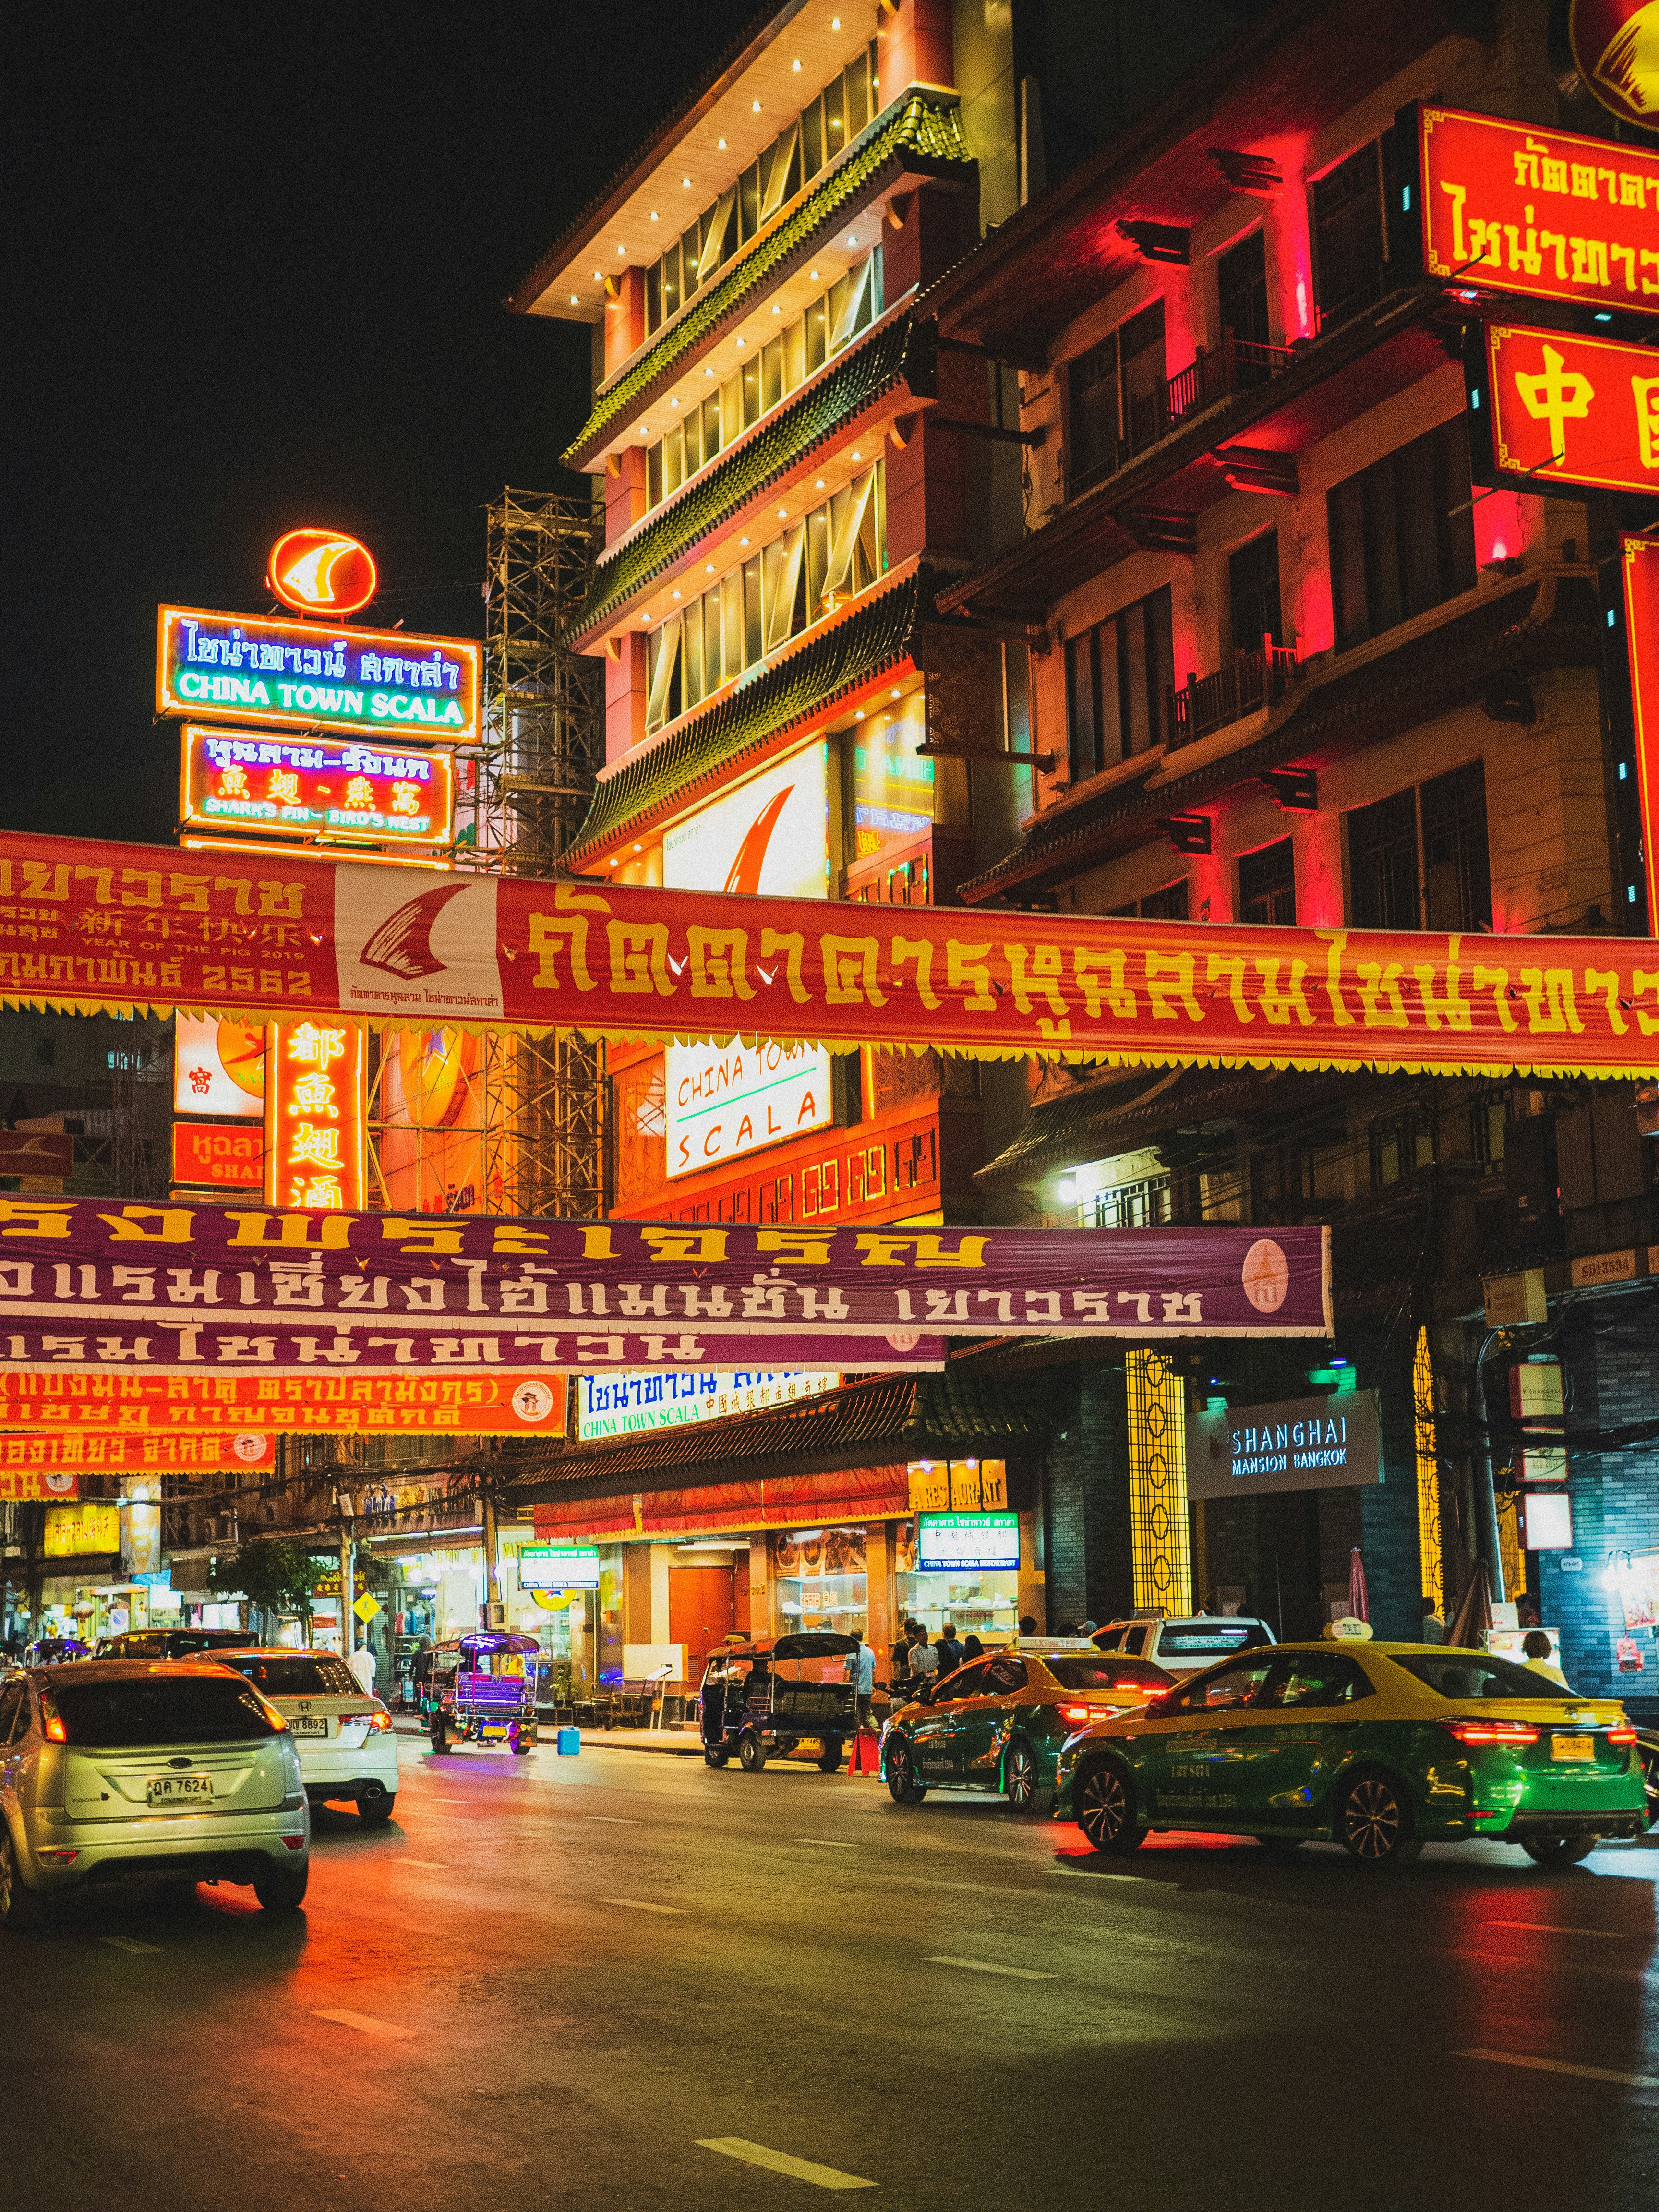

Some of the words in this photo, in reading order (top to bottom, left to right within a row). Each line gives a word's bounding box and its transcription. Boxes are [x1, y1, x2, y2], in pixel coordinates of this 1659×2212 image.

[181, 619, 347, 678] ไชน่าทาวน์
[178, 673, 270, 705] CHINA
[278, 683, 364, 715] TOWN
[370, 692, 464, 725] SCALA
[205, 798, 277, 818] SHARK'S
[328, 809, 384, 827] BIRD'S
[387, 816, 430, 832] NEST
[81, 937, 129, 948] YEAR
[140, 942, 165, 950] OF
[174, 944, 210, 954] THE
[221, 948, 251, 956] PIG
[262, 950, 304, 960] 2019
[202, 964, 312, 996] 2562
[678, 1055, 743, 1106] CHINA
[678, 1091, 816, 1168] SCALA
[893, 1289, 1203, 1323] เยาวราช
[583, 1418, 617, 1438] CHINA
[622, 1411, 655, 1431] TOWN
[659, 1404, 699, 1426] SCALA
[1232, 1417, 1346, 1455] SHANGHAI
[1231, 1454, 1287, 1476] MANSION
[1294, 1448, 1347, 1469] BANGKOK
[302, 1720, 324, 1729] 8892
[176, 1779, 208, 1793] 7624
